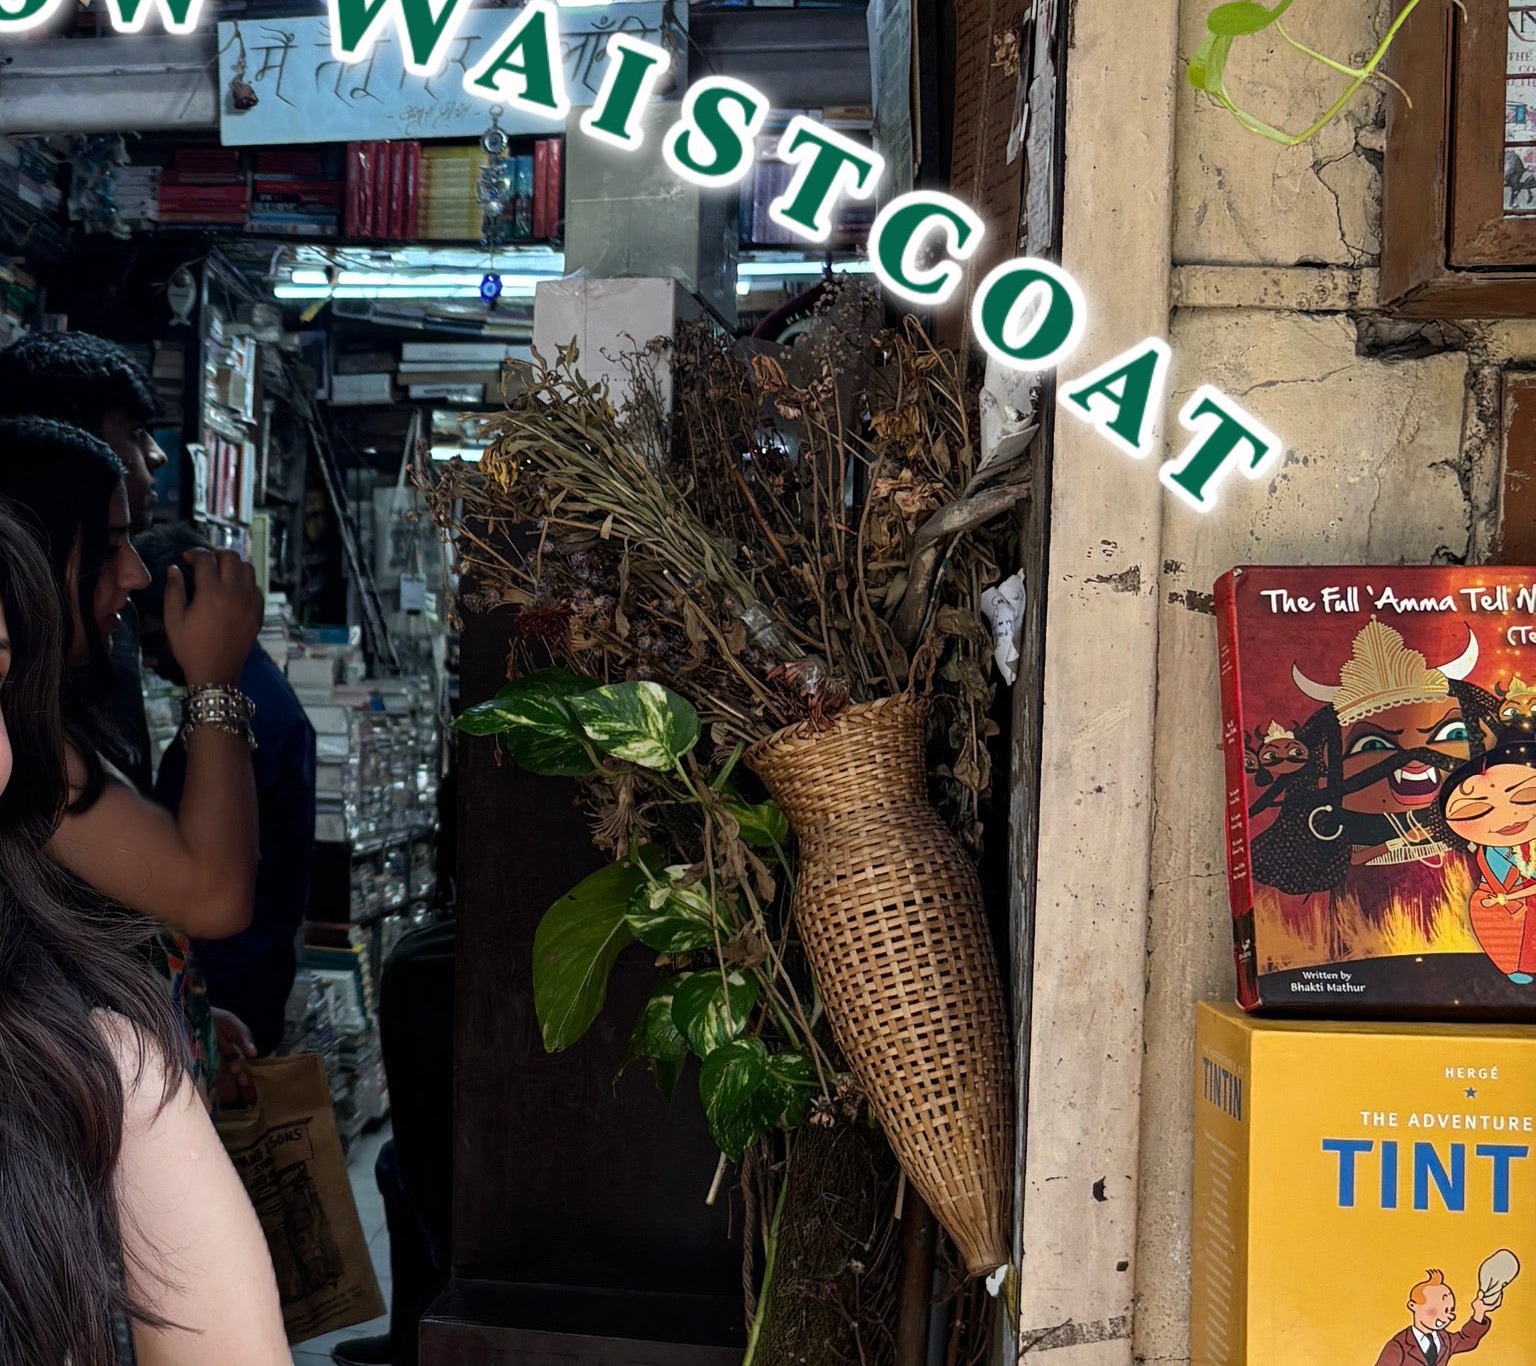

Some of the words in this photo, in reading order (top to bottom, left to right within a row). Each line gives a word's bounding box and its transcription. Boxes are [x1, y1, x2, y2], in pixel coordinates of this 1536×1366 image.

[1260, 588, 1316, 614] The
[1320, 585, 1360, 614] Full
[1459, 584, 1510, 614] Tell
[1302, 970, 1339, 981] Written
[1339, 970, 1352, 982] by
[1290, 982, 1324, 993] Bhakti
[1326, 982, 1366, 993] Mathur
[1444, 1065, 1499, 1080] HERGÉ
[1202, 1056, 1242, 1123] TINTIN
[1360, 1111, 1399, 1127] THE
[1407, 1113, 1533, 1132] ADVENTURE
[1321, 1138, 1530, 1215] TINT
